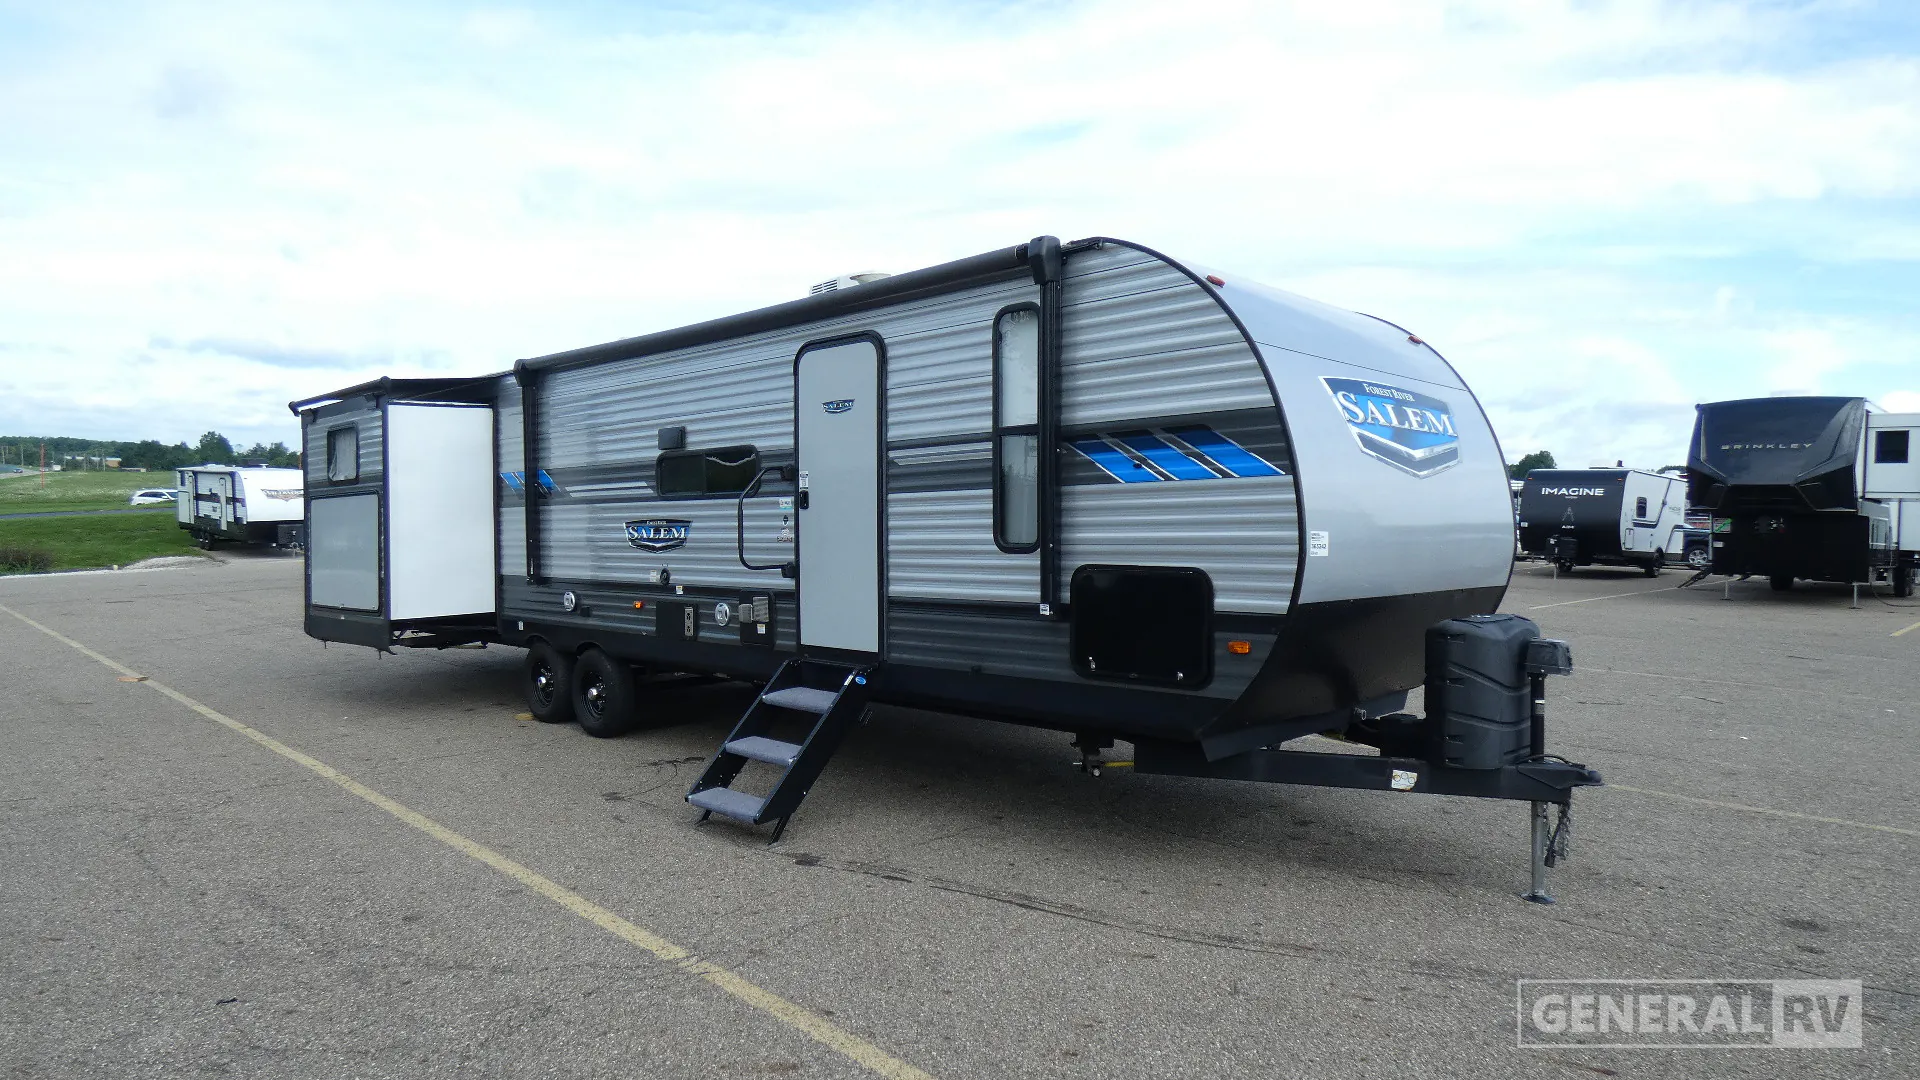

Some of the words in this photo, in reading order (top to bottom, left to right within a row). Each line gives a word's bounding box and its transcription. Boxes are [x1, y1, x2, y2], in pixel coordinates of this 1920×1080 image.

[1363, 383, 1393, 398] FOREST
[1392, 389, 1416, 402] RIVER
[822, 401, 854, 410] SALEM
[1336, 391, 1458, 437] SALEM
[1720, 442, 1813, 450] BRINKLEY
[1541, 487, 1605, 496] IMAGINE
[628, 525, 686, 540] SALEM
